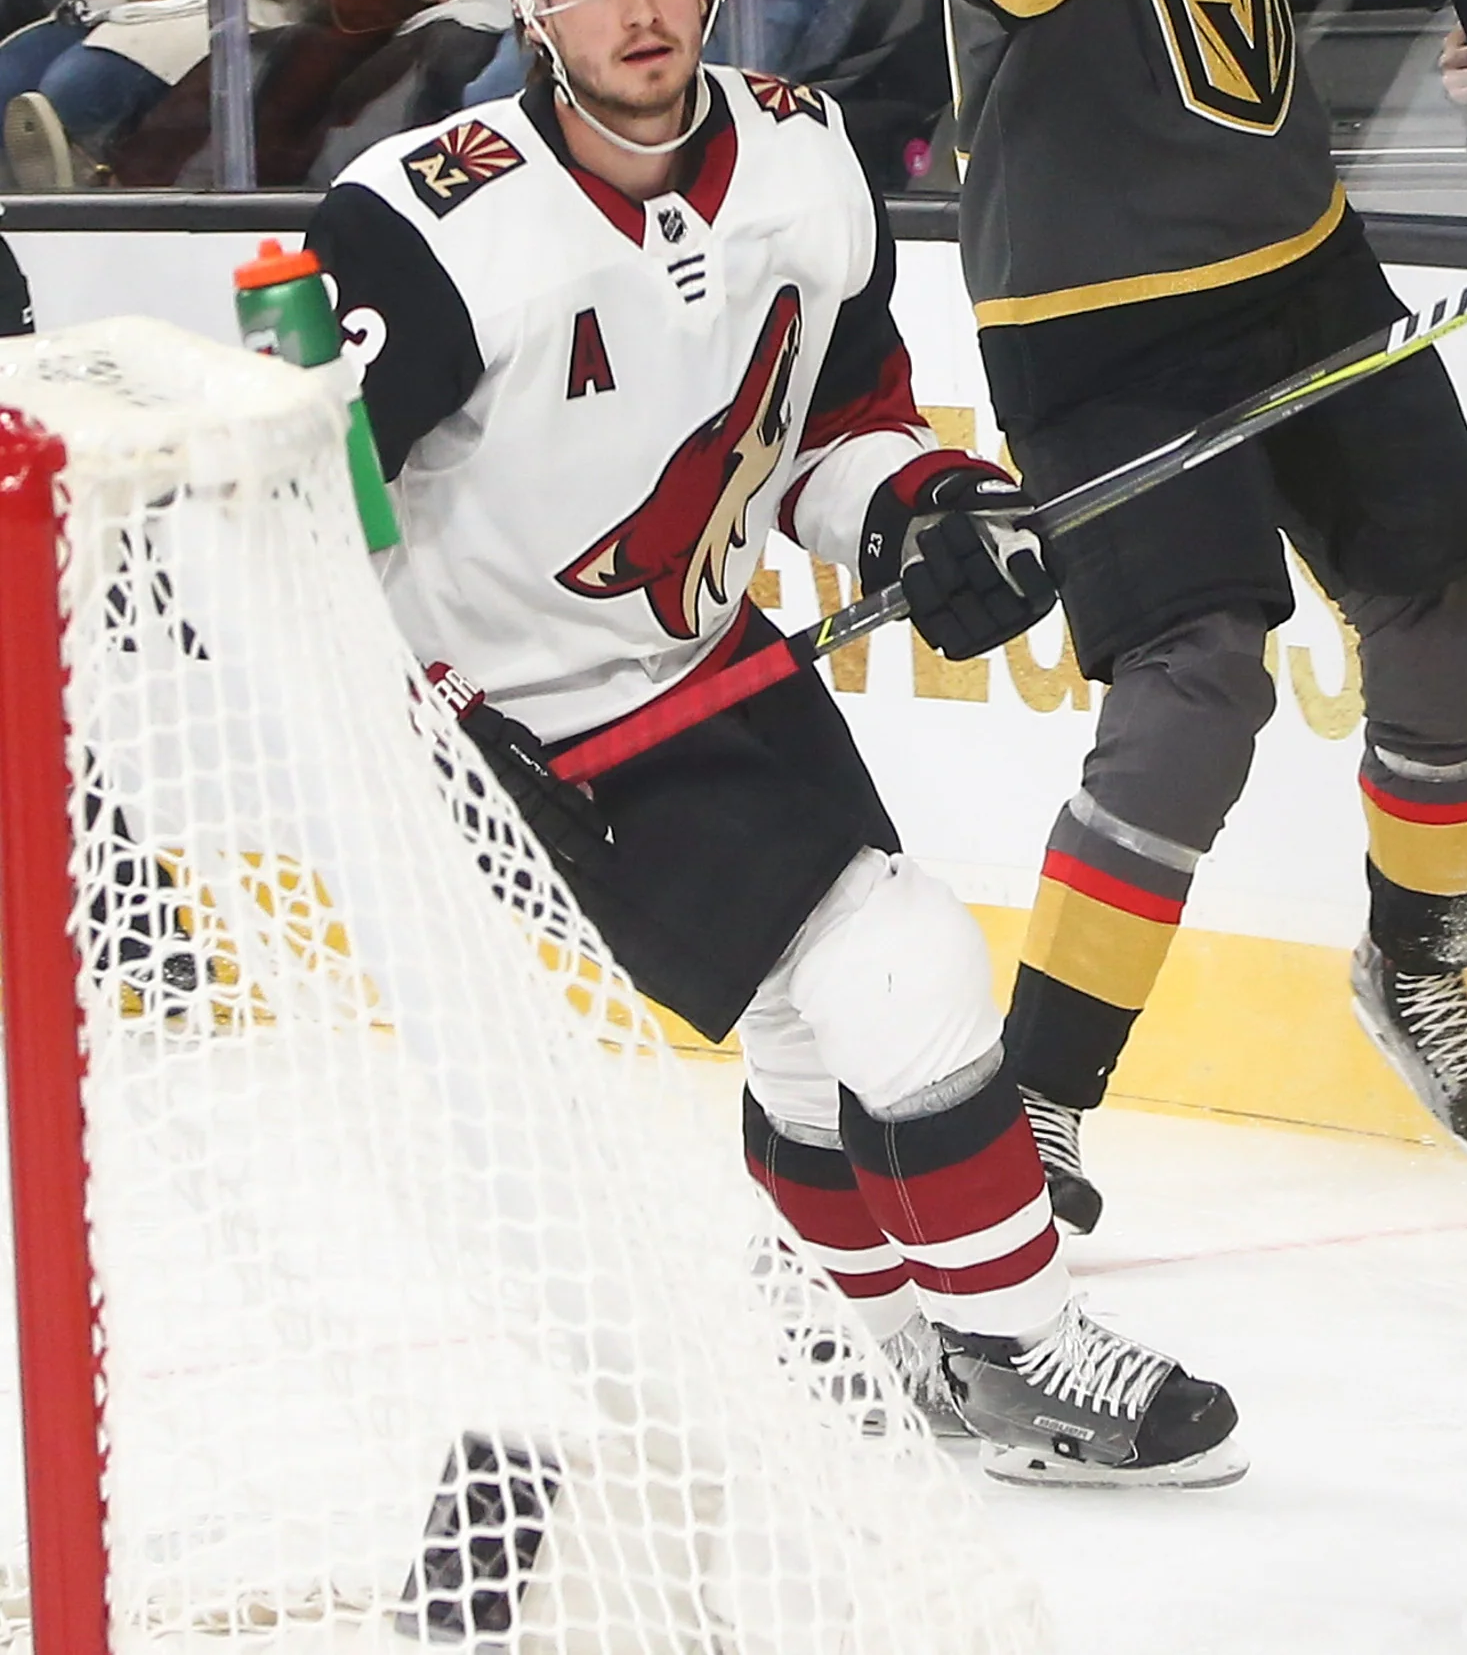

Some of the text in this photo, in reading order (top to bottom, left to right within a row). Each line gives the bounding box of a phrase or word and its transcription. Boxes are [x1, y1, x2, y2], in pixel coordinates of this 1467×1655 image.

[408, 152, 470, 199] AZ
[566, 307, 617, 401] A
[868, 532, 884, 558] 23
